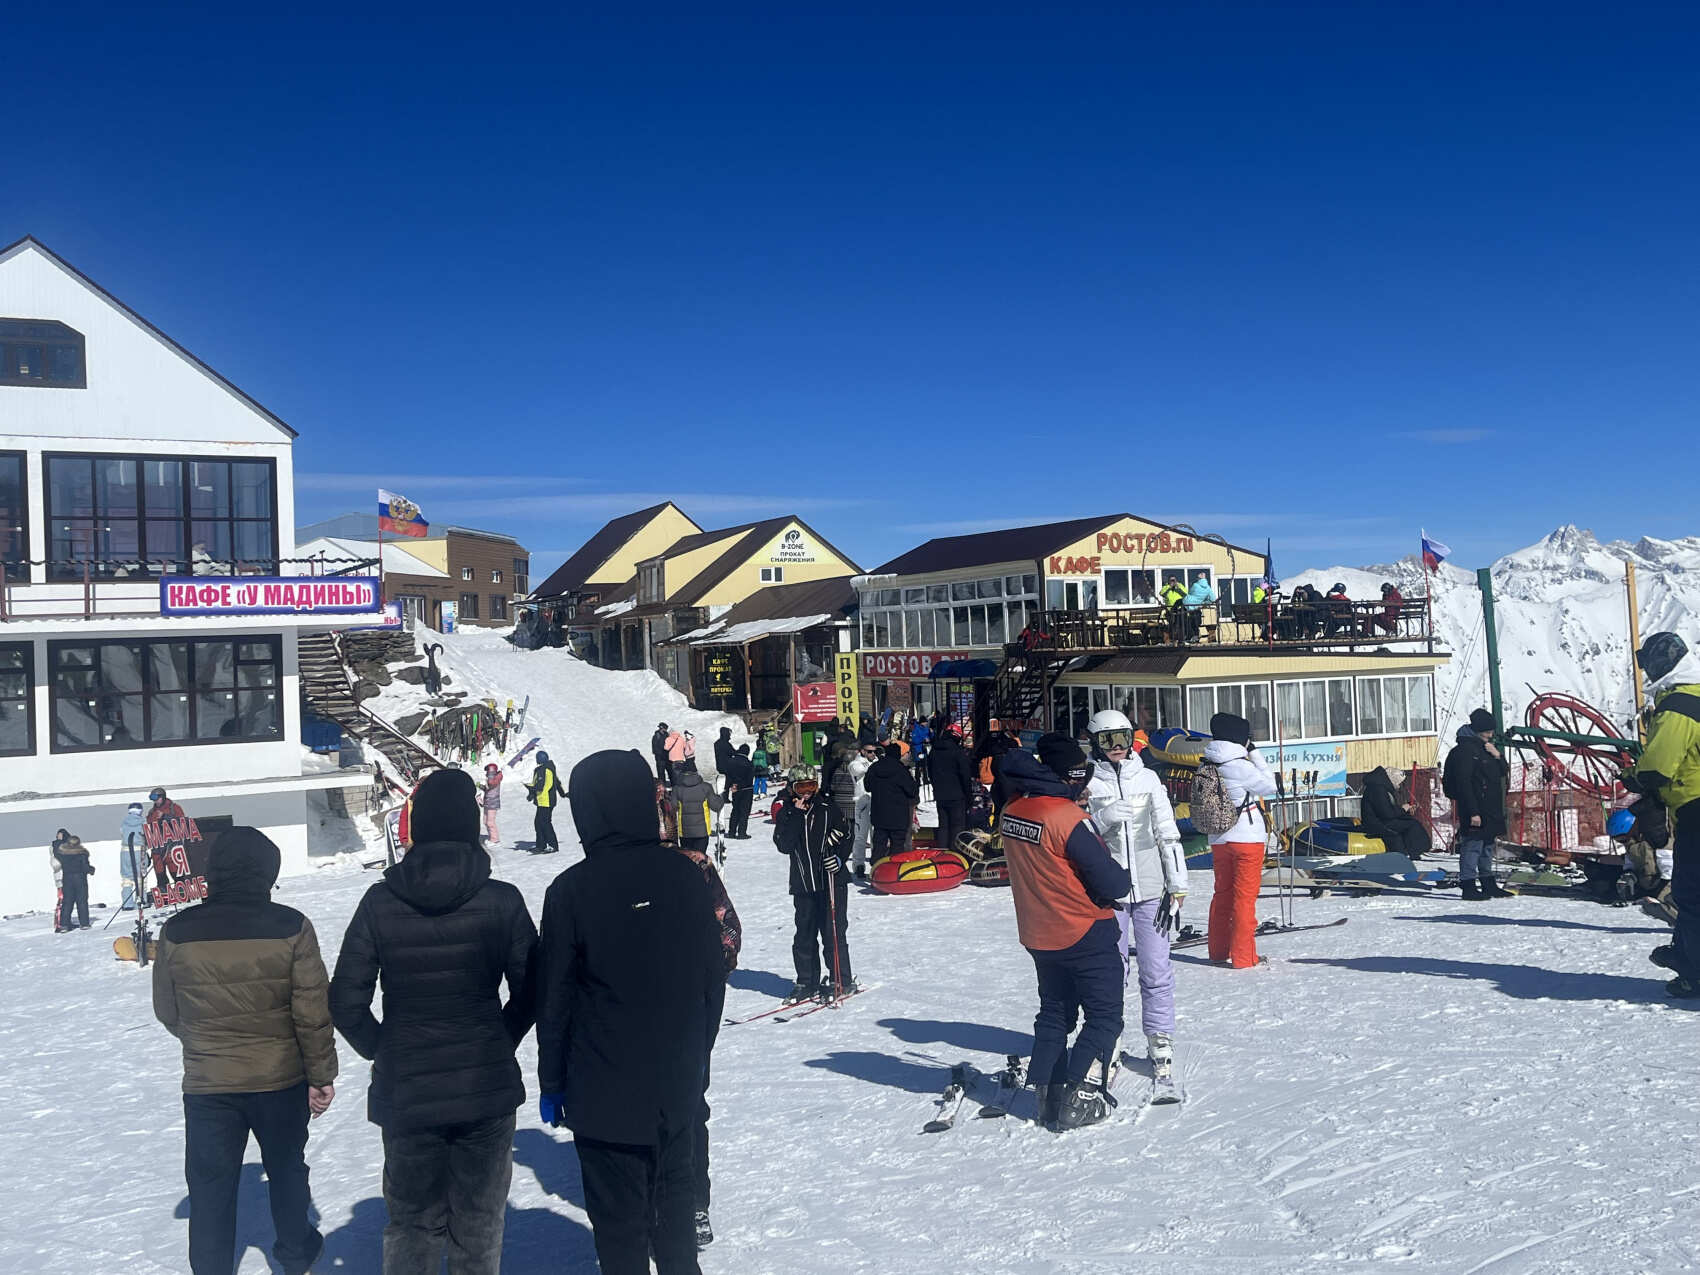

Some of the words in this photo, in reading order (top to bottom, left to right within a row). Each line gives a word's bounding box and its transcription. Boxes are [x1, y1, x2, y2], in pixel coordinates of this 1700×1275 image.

[1049, 556, 1101, 575] КАФЕ
[169, 584, 232, 608] КАФЕ
[236, 584, 259, 606] «У
[263, 584, 372, 609] МАДИНЫ»
[840, 657, 855, 728] ПРОКА
[143, 817, 203, 849] МАМА
[171, 845, 191, 878] Я
[166, 876, 208, 905] ДОМБ
